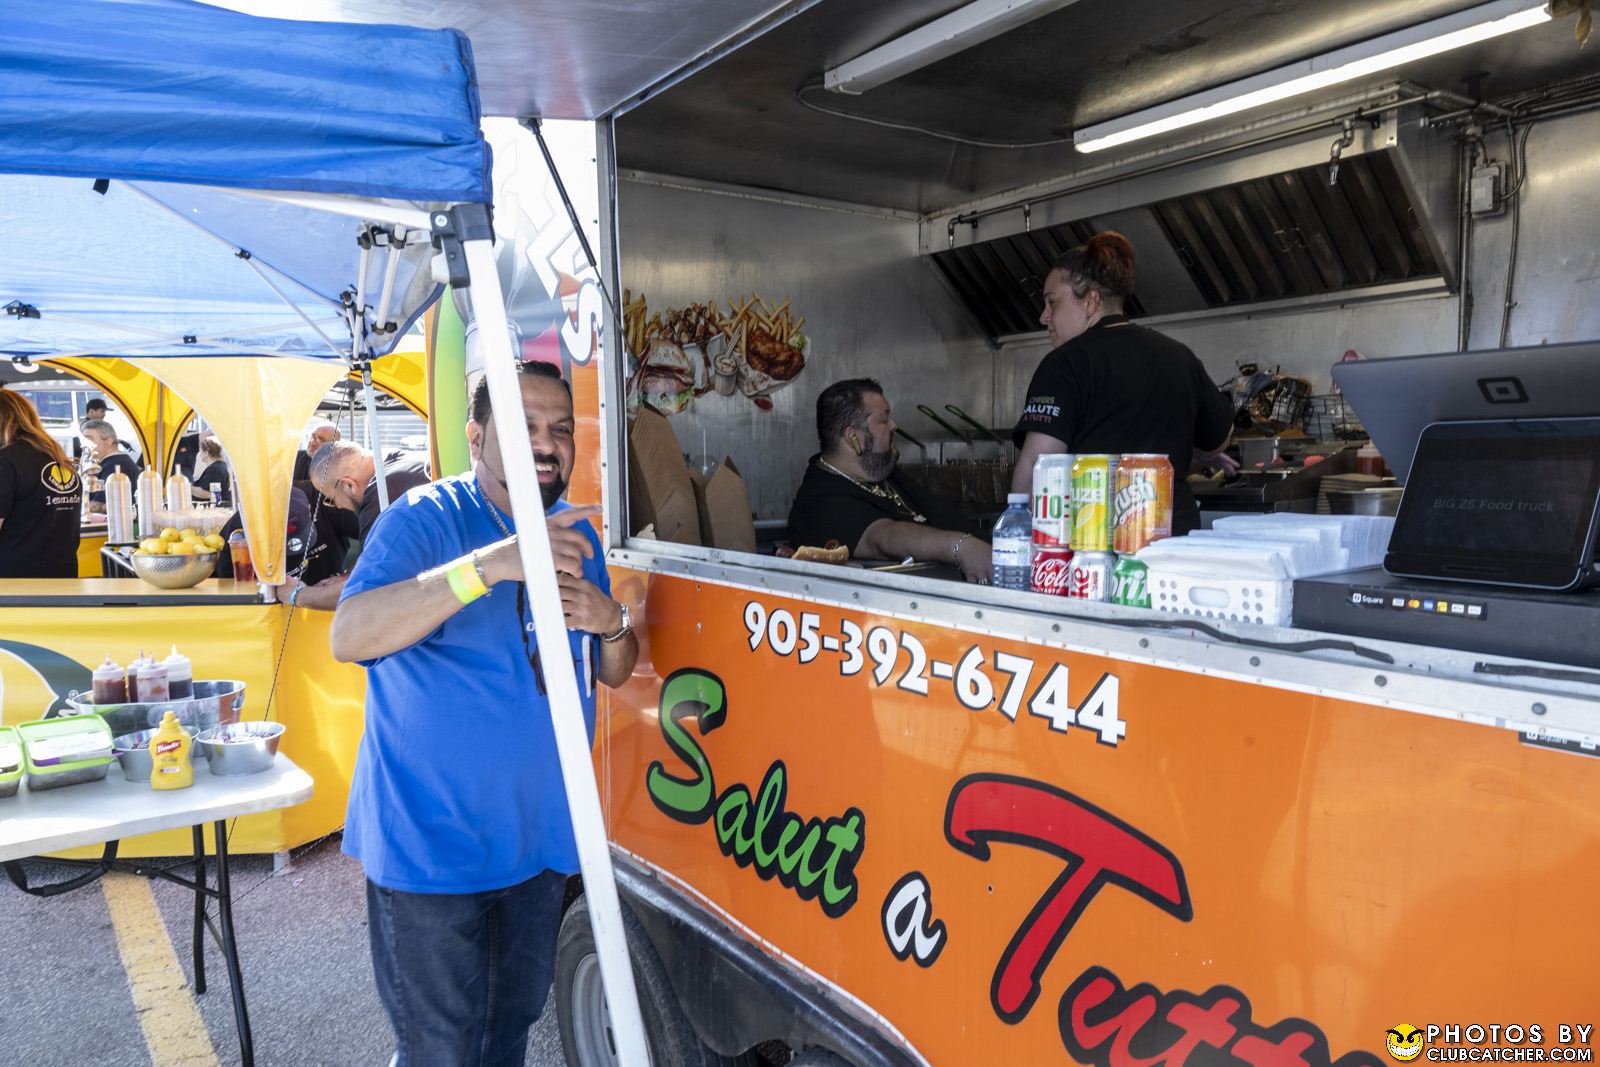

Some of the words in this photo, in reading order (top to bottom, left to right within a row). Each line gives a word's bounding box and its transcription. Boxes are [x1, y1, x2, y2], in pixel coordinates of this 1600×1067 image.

[1032, 487, 1062, 519] rio
[1480, 499, 1514, 511] Food
[1518, 500, 1554, 512] truck
[1034, 558, 1071, 588] Cola
[1071, 566, 1089, 598] ke
[1362, 595, 1384, 604] Square
[743, 600, 1126, 747] 905-392-6744
[646, 667, 865, 918] Salut
[881, 871, 948, 968] a
